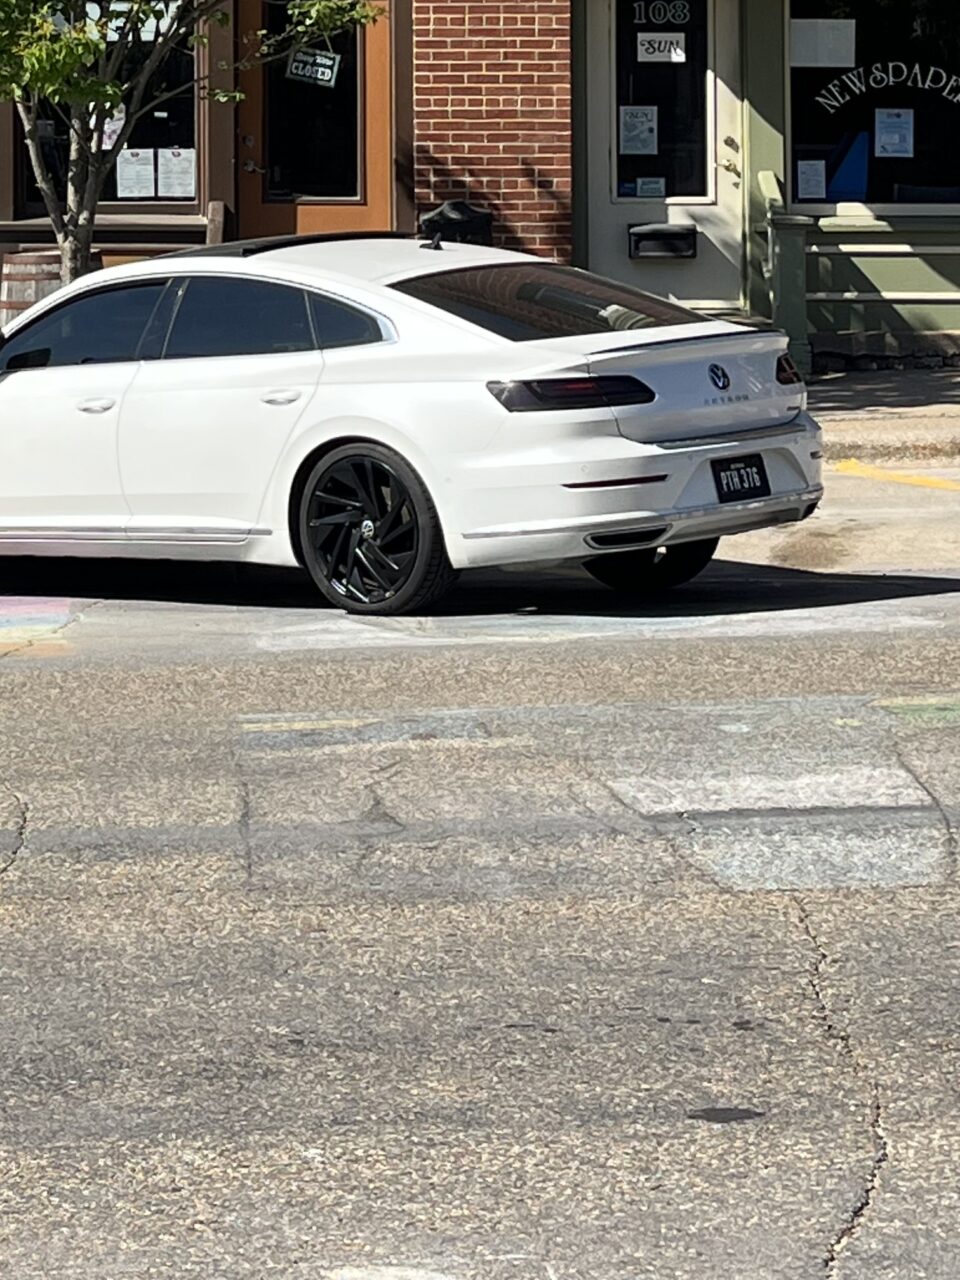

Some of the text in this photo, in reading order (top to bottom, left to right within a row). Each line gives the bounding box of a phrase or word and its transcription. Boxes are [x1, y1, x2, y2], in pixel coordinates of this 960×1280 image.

[633, 1, 690, 24] 108
[291, 62, 332, 81] CLOSED
[814, 61, 960, 114] NEWSPAPE
